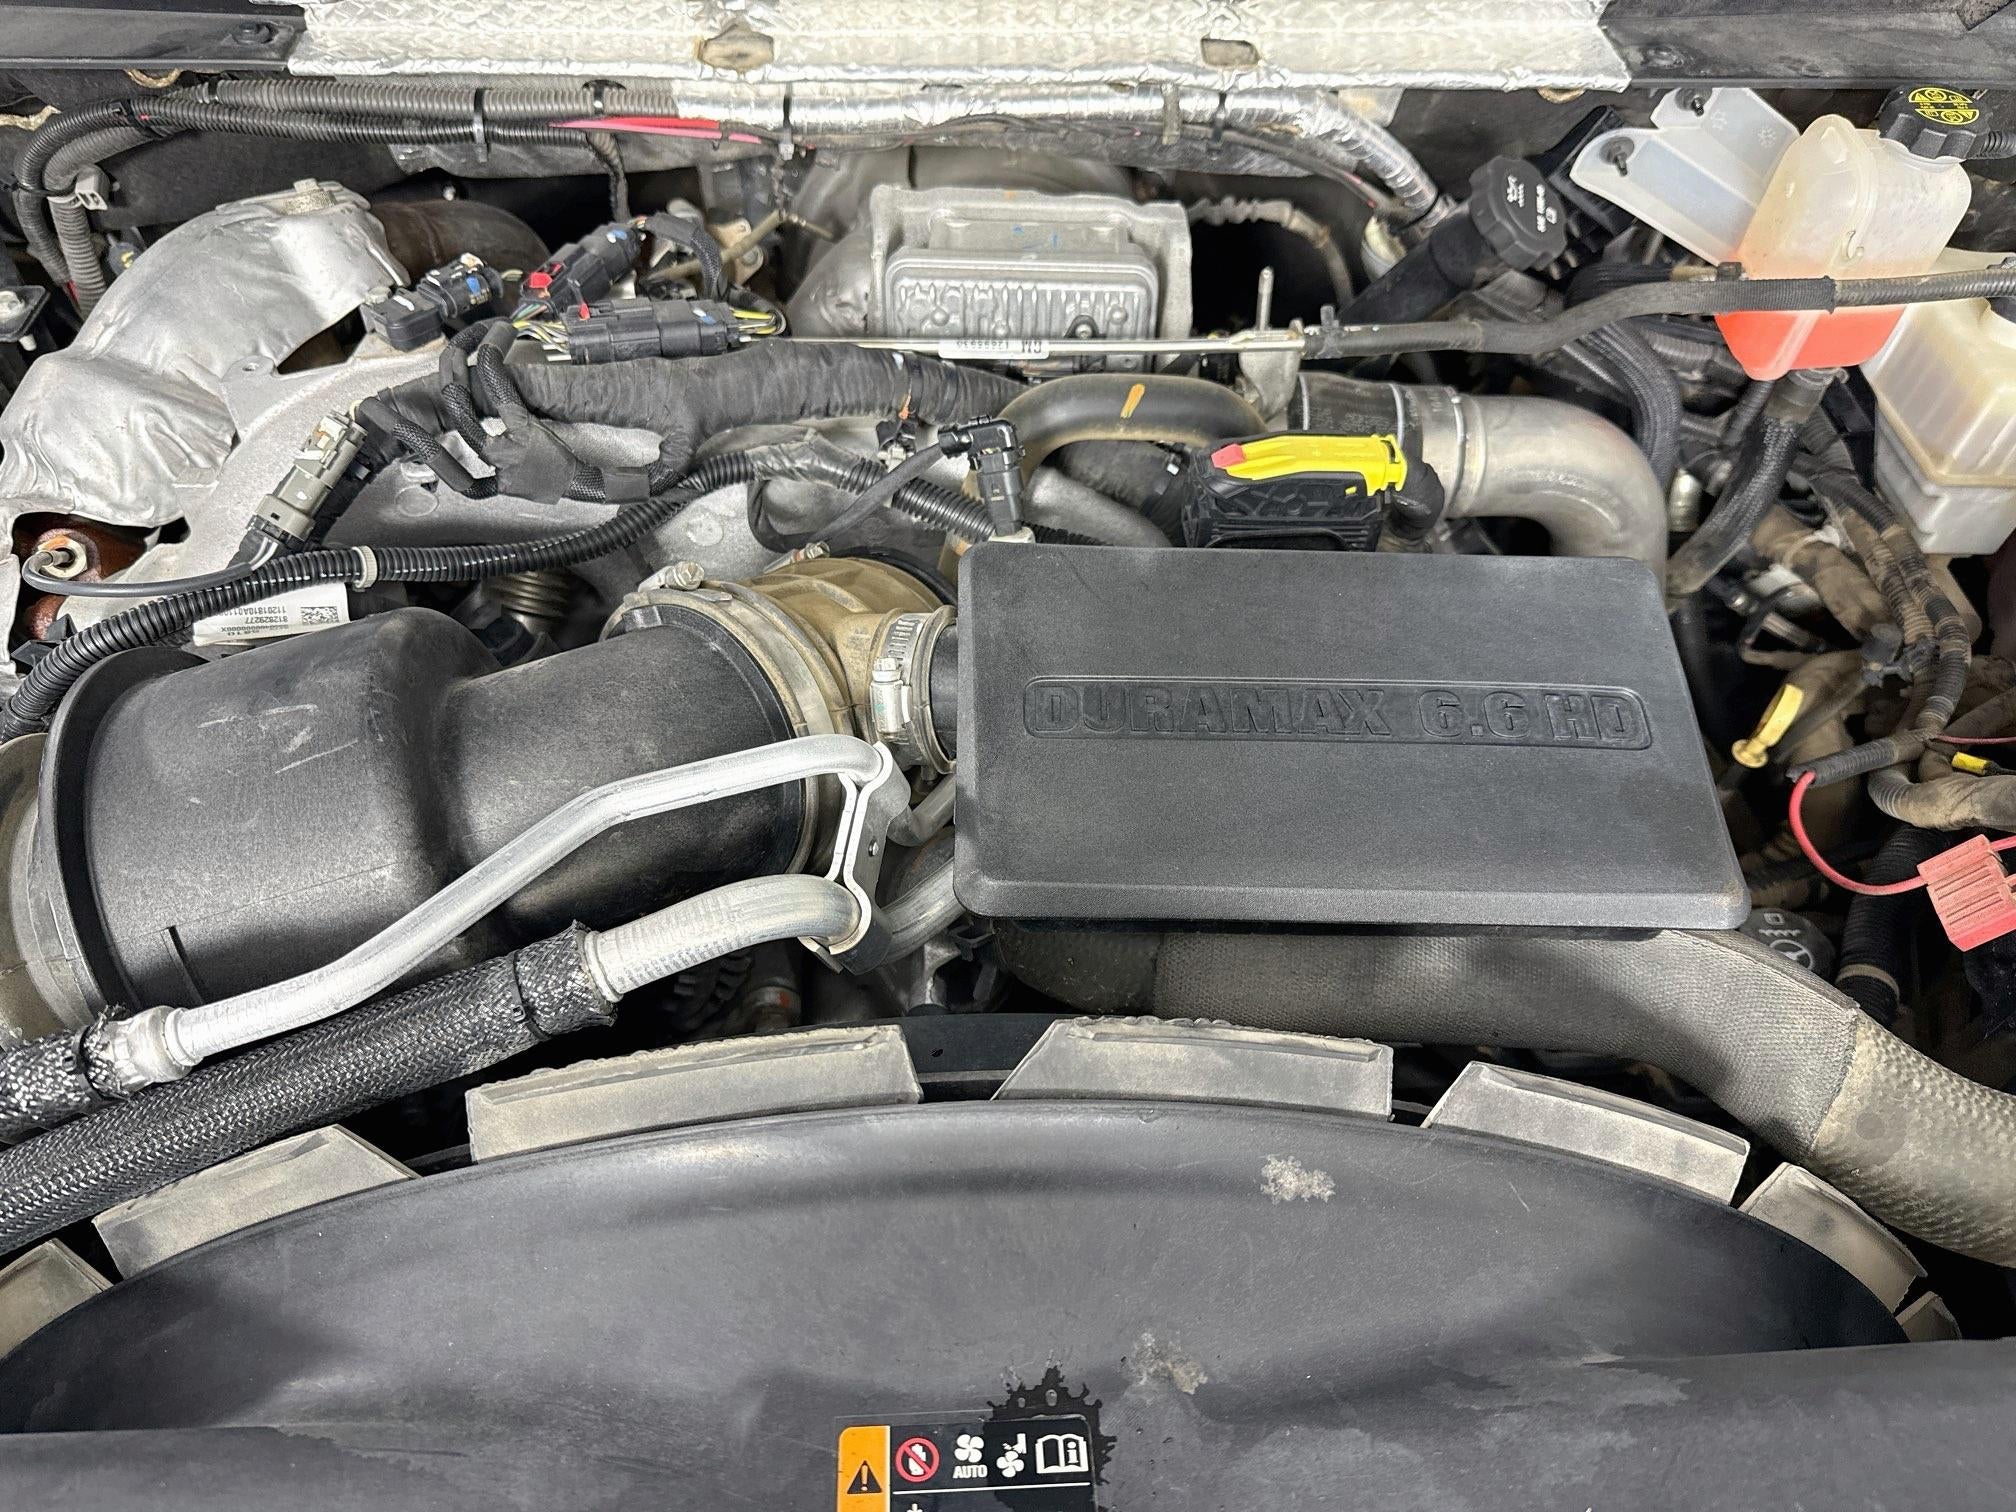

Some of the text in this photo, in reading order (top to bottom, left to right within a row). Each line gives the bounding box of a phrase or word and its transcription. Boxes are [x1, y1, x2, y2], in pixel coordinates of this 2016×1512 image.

[1034, 685, 1640, 741] DURAMAX 6.6 HD
[953, 1464, 988, 1479] AUTO
